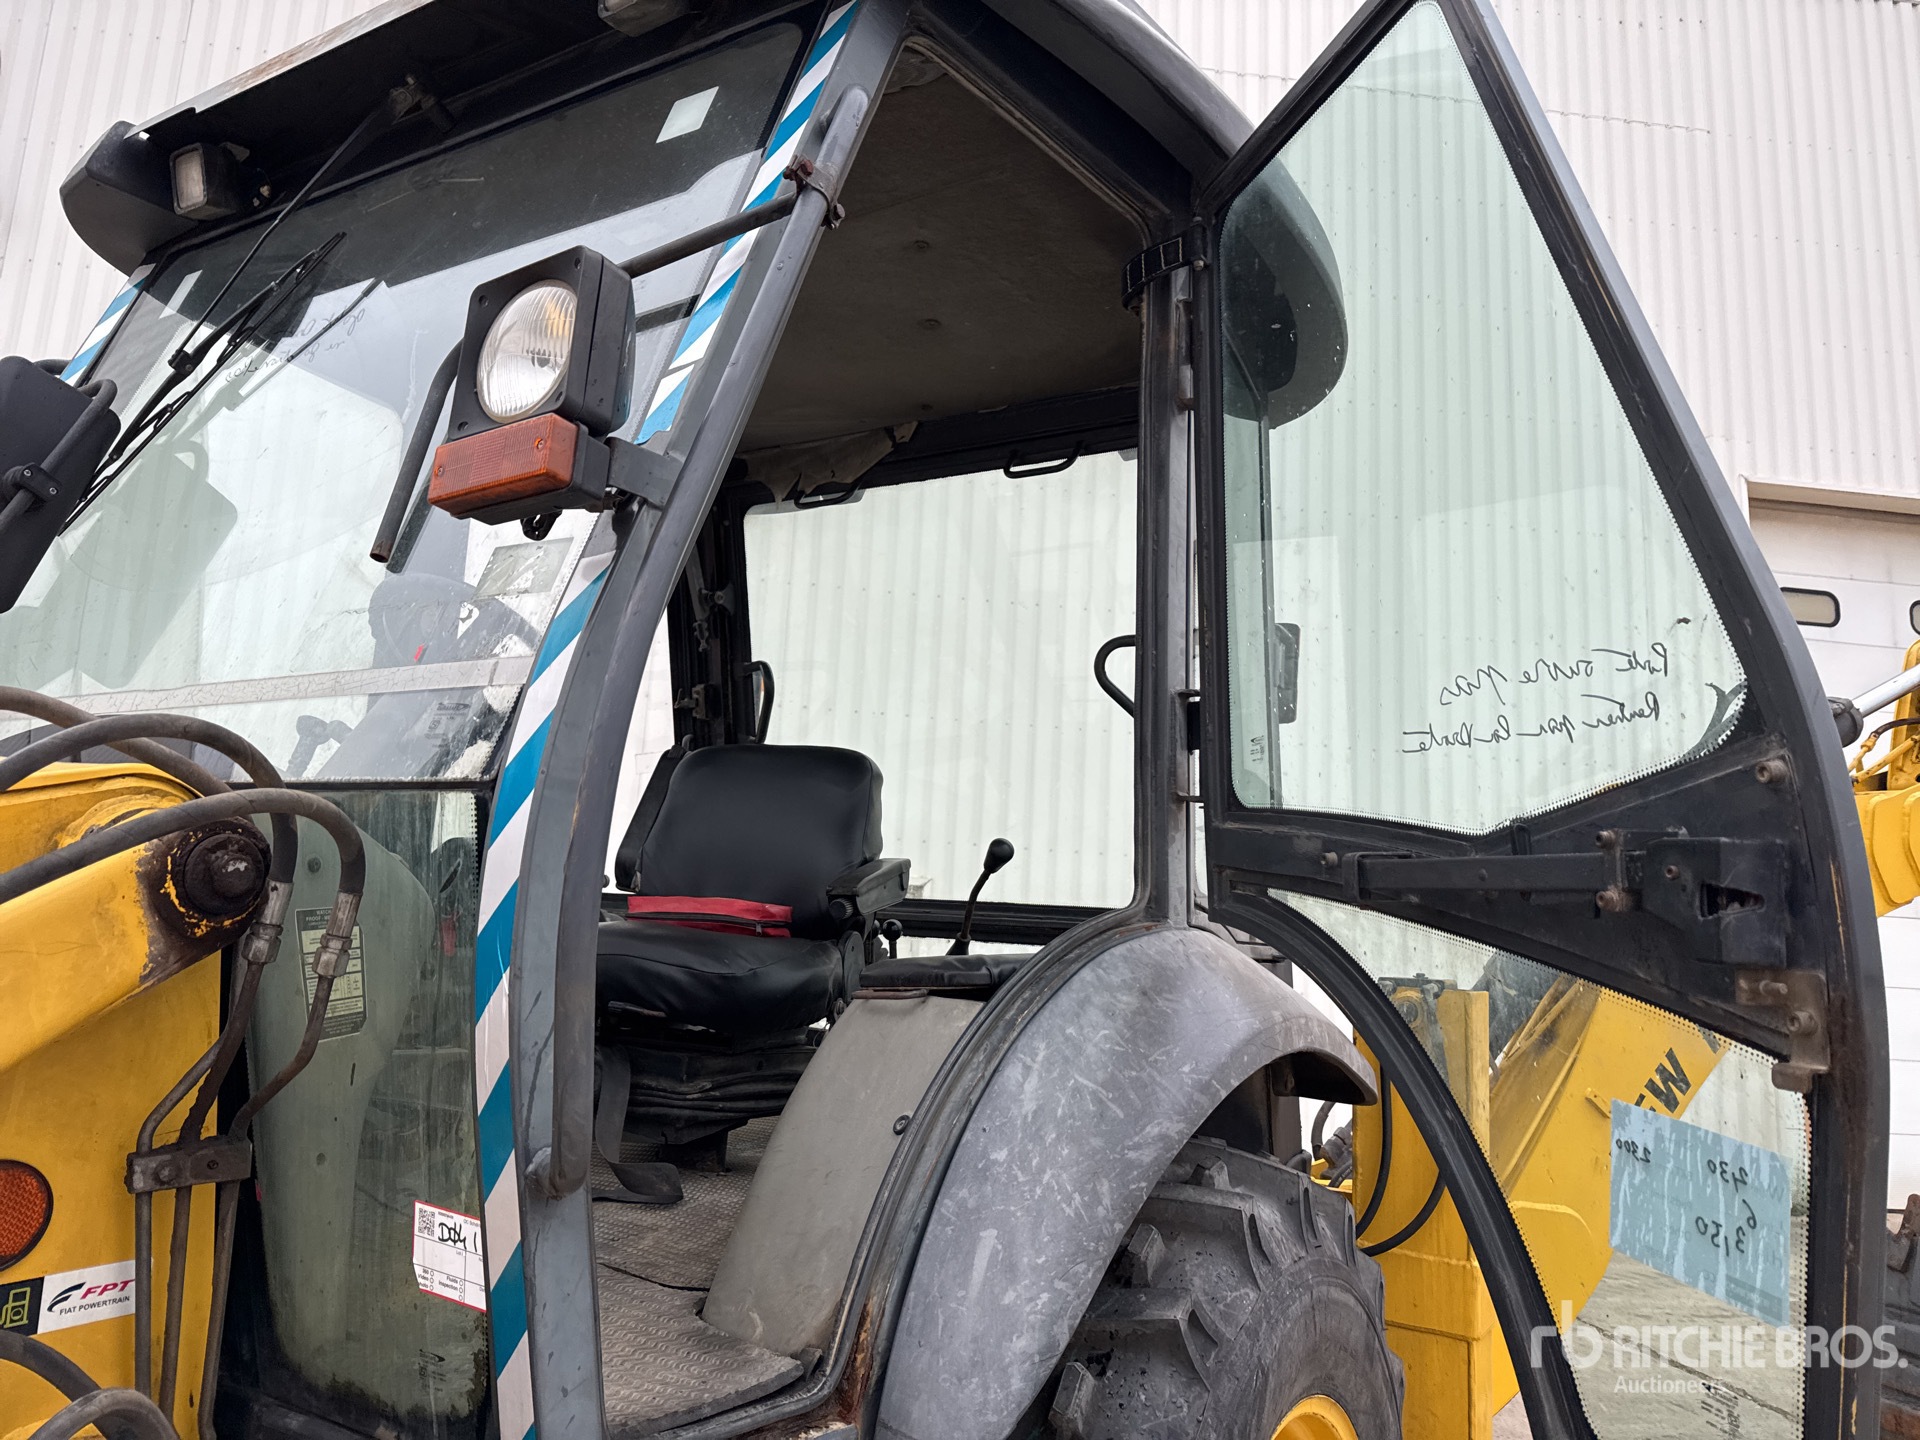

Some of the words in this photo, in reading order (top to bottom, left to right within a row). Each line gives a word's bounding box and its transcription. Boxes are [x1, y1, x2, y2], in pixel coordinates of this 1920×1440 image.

[80, 1279, 136, 1300] FPT
[438, 1280, 458, 1291] Inspection
[60, 1306, 77, 1316] FIAT
[78, 1295, 130, 1312] POWERTRAIN
